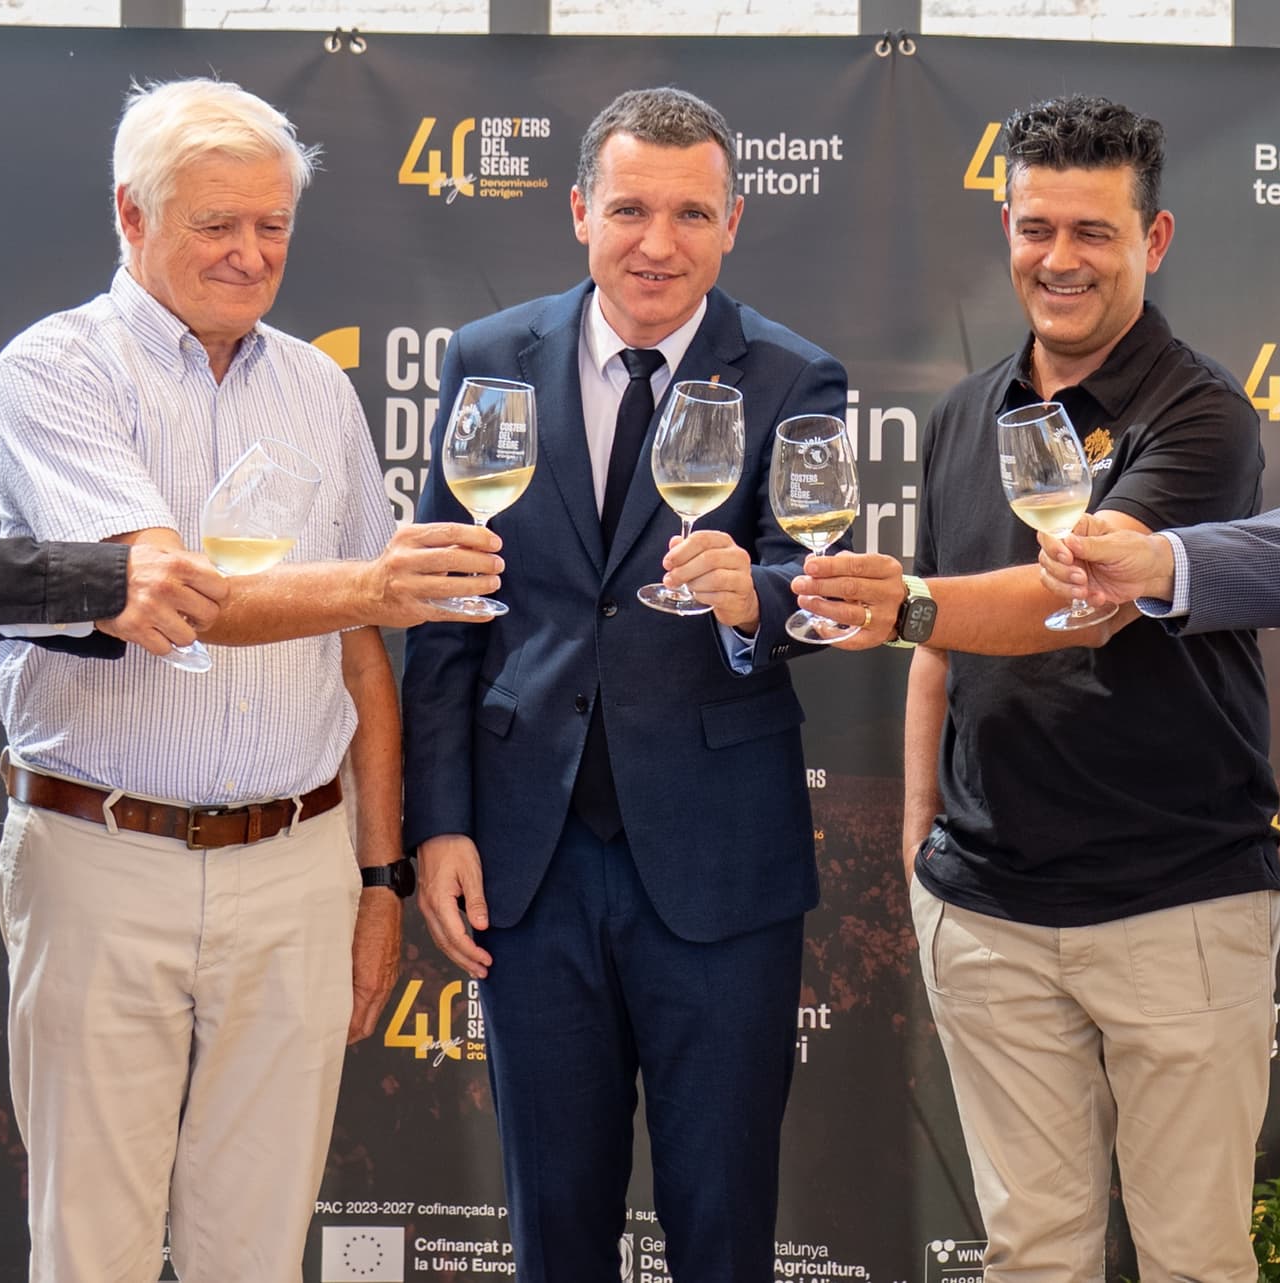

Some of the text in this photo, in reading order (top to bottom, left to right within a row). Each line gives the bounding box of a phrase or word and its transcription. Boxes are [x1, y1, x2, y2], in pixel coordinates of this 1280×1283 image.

[481, 117, 551, 138] COS7ERS
[480, 138, 509, 156] DEL
[735, 132, 844, 161] indant
[480, 157, 530, 176] SEGRE
[963, 122, 1007, 202] 4
[480, 178, 549, 188] Denominació
[737, 166, 820, 194] ritori
[315, 1202, 343, 1214] PAC
[346, 1202, 415, 1214] 2023-2027
[418, 1204, 495, 1218] cofinançada
[414, 1238, 498, 1254] Cofinançat
[775, 1240, 828, 1260] talunya
[956, 1249, 983, 1262] WIN
[414, 1258, 516, 1274] la Unió Europ
[774, 1258, 871, 1281] Agricultura,
